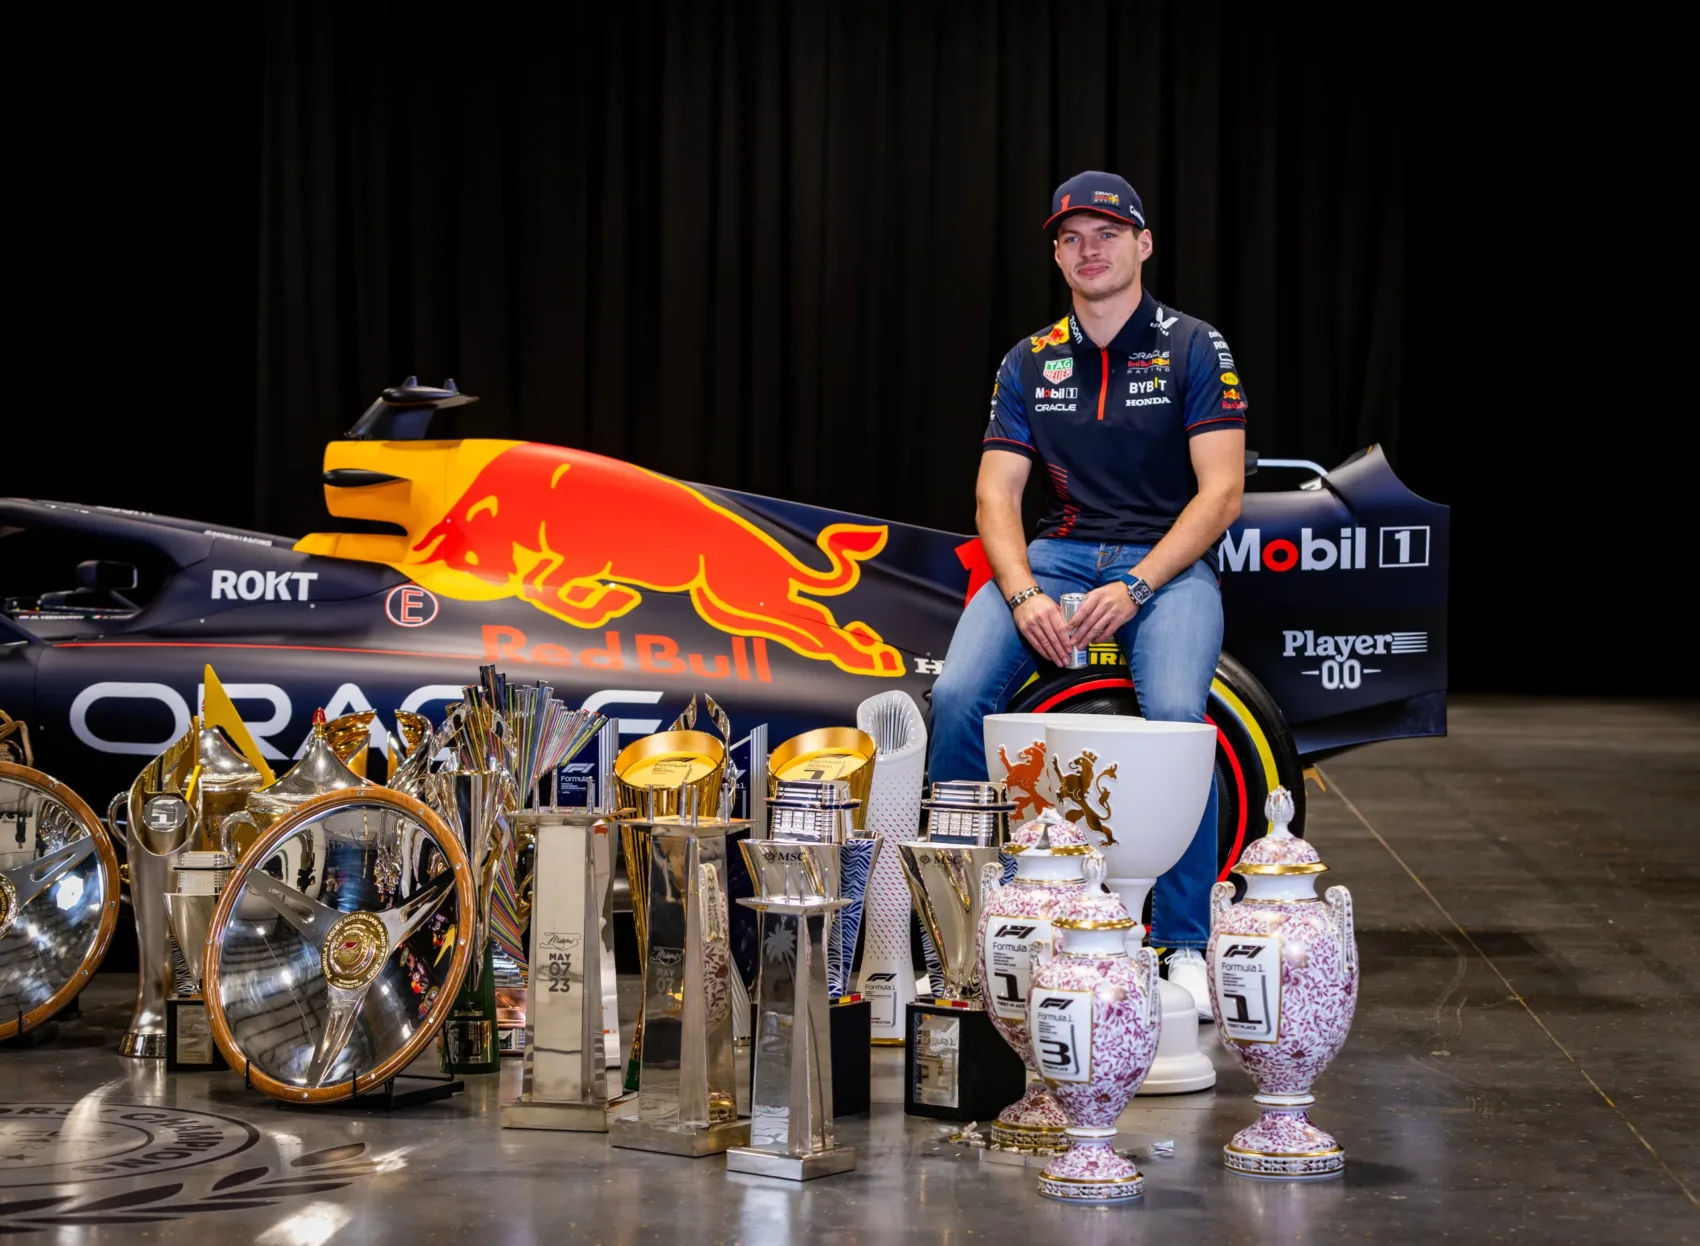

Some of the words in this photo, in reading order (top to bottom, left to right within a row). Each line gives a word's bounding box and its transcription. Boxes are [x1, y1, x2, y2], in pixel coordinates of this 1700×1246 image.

[1061, 194, 1071, 211] 1
[1070, 316, 1083, 344] zoom
[1048, 360, 1072, 370] TAG
[1045, 370, 1072, 382] HEUER
[1035, 387, 1065, 399] Mobil
[1129, 377, 1167, 394] BYBIT
[1035, 403, 1077, 412] ORACLE
[1125, 397, 1171, 407] HONDA
[1218, 527, 1367, 572] Mobil
[211, 569, 318, 601] ROKT
[1282, 630, 1393, 662] Player
[481, 625, 625, 671] Red
[635, 634, 773, 683] Bull
[778, 851, 805, 862] MSC
[934, 855, 962, 864] MSC
[326, 921, 344, 941] ROLEX
[343, 914, 379, 927] AUSTRALIAN
[376, 924, 386, 946] GRAND
[548, 934, 575, 945] Miami
[992, 941, 1027, 952] Formula
[549, 953, 571, 961] MAY
[548, 962, 571, 977] 07
[1222, 962, 1257, 972] Formula
[548, 978, 570, 993] 23
[656, 978, 675, 993] 07
[995, 972, 1027, 1002] 1
[1223, 993, 1263, 1024] 1
[1037, 1012, 1066, 1022] Formula
[1228, 1022, 1240, 1030] FIRST
[1039, 1039, 1071, 1066] 3
